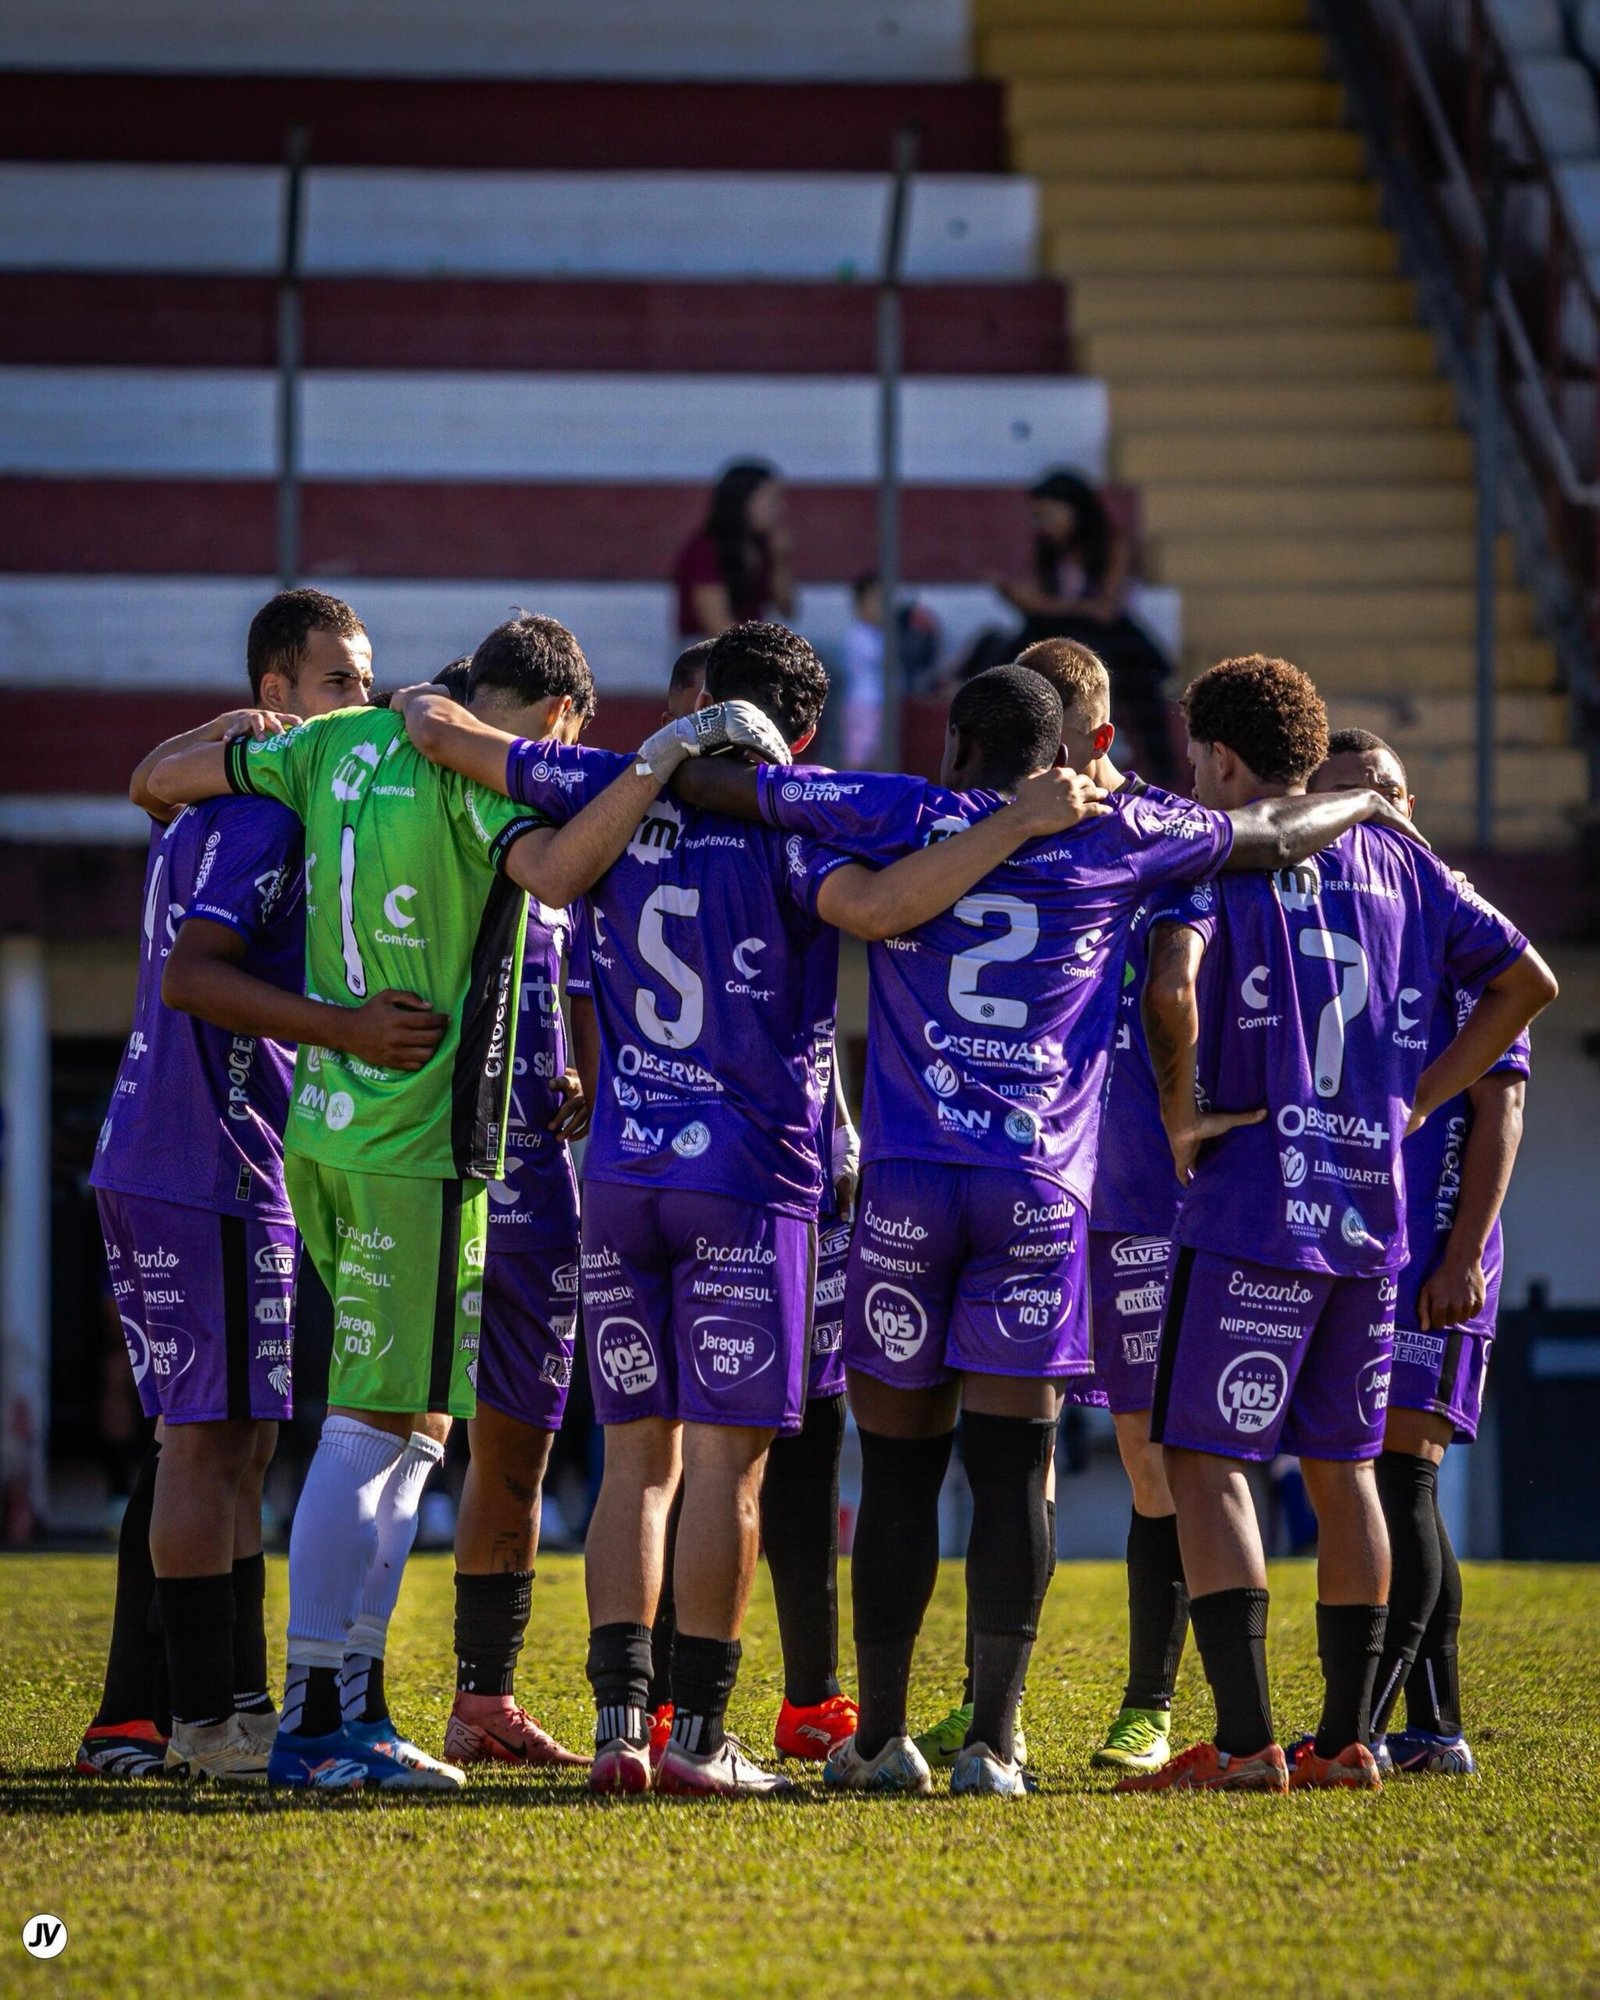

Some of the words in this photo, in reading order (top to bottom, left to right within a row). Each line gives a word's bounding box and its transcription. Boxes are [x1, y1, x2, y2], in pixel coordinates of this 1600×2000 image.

[802, 790, 840, 801] GYM
[374, 929, 425, 949] Comfort
[884, 937, 917, 952] mfort
[635, 884, 704, 1050] 5
[948, 893, 1040, 1029] 2
[1299, 927, 1369, 1098] 7
[864, 1201, 928, 1242] Encanto
[1013, 1193, 1076, 1226] Encanto
[1286, 1199, 1332, 1228] KNN
[696, 1237, 777, 1264] Encanto
[860, 1246, 926, 1274] NIPPONSUL
[692, 1280, 774, 1302] NIPPONSUL
[1228, 1270, 1314, 1304] Encanto
[1018, 1306, 1049, 1327] 101.3
[1240, 1301, 1263, 1310] MODA
[1265, 1303, 1300, 1314] INFANTIL
[873, 1309, 915, 1338] 105
[1220, 1316, 1303, 1339] NIPPONSUL
[255, 1345, 291, 1360] JARAG
[699, 1329, 755, 1356] Jaraguá
[1394, 1332, 1443, 1353] EMARCHI
[603, 1341, 650, 1378] 105
[713, 1355, 740, 1375] 101.3
[1228, 1381, 1277, 1409] 105
